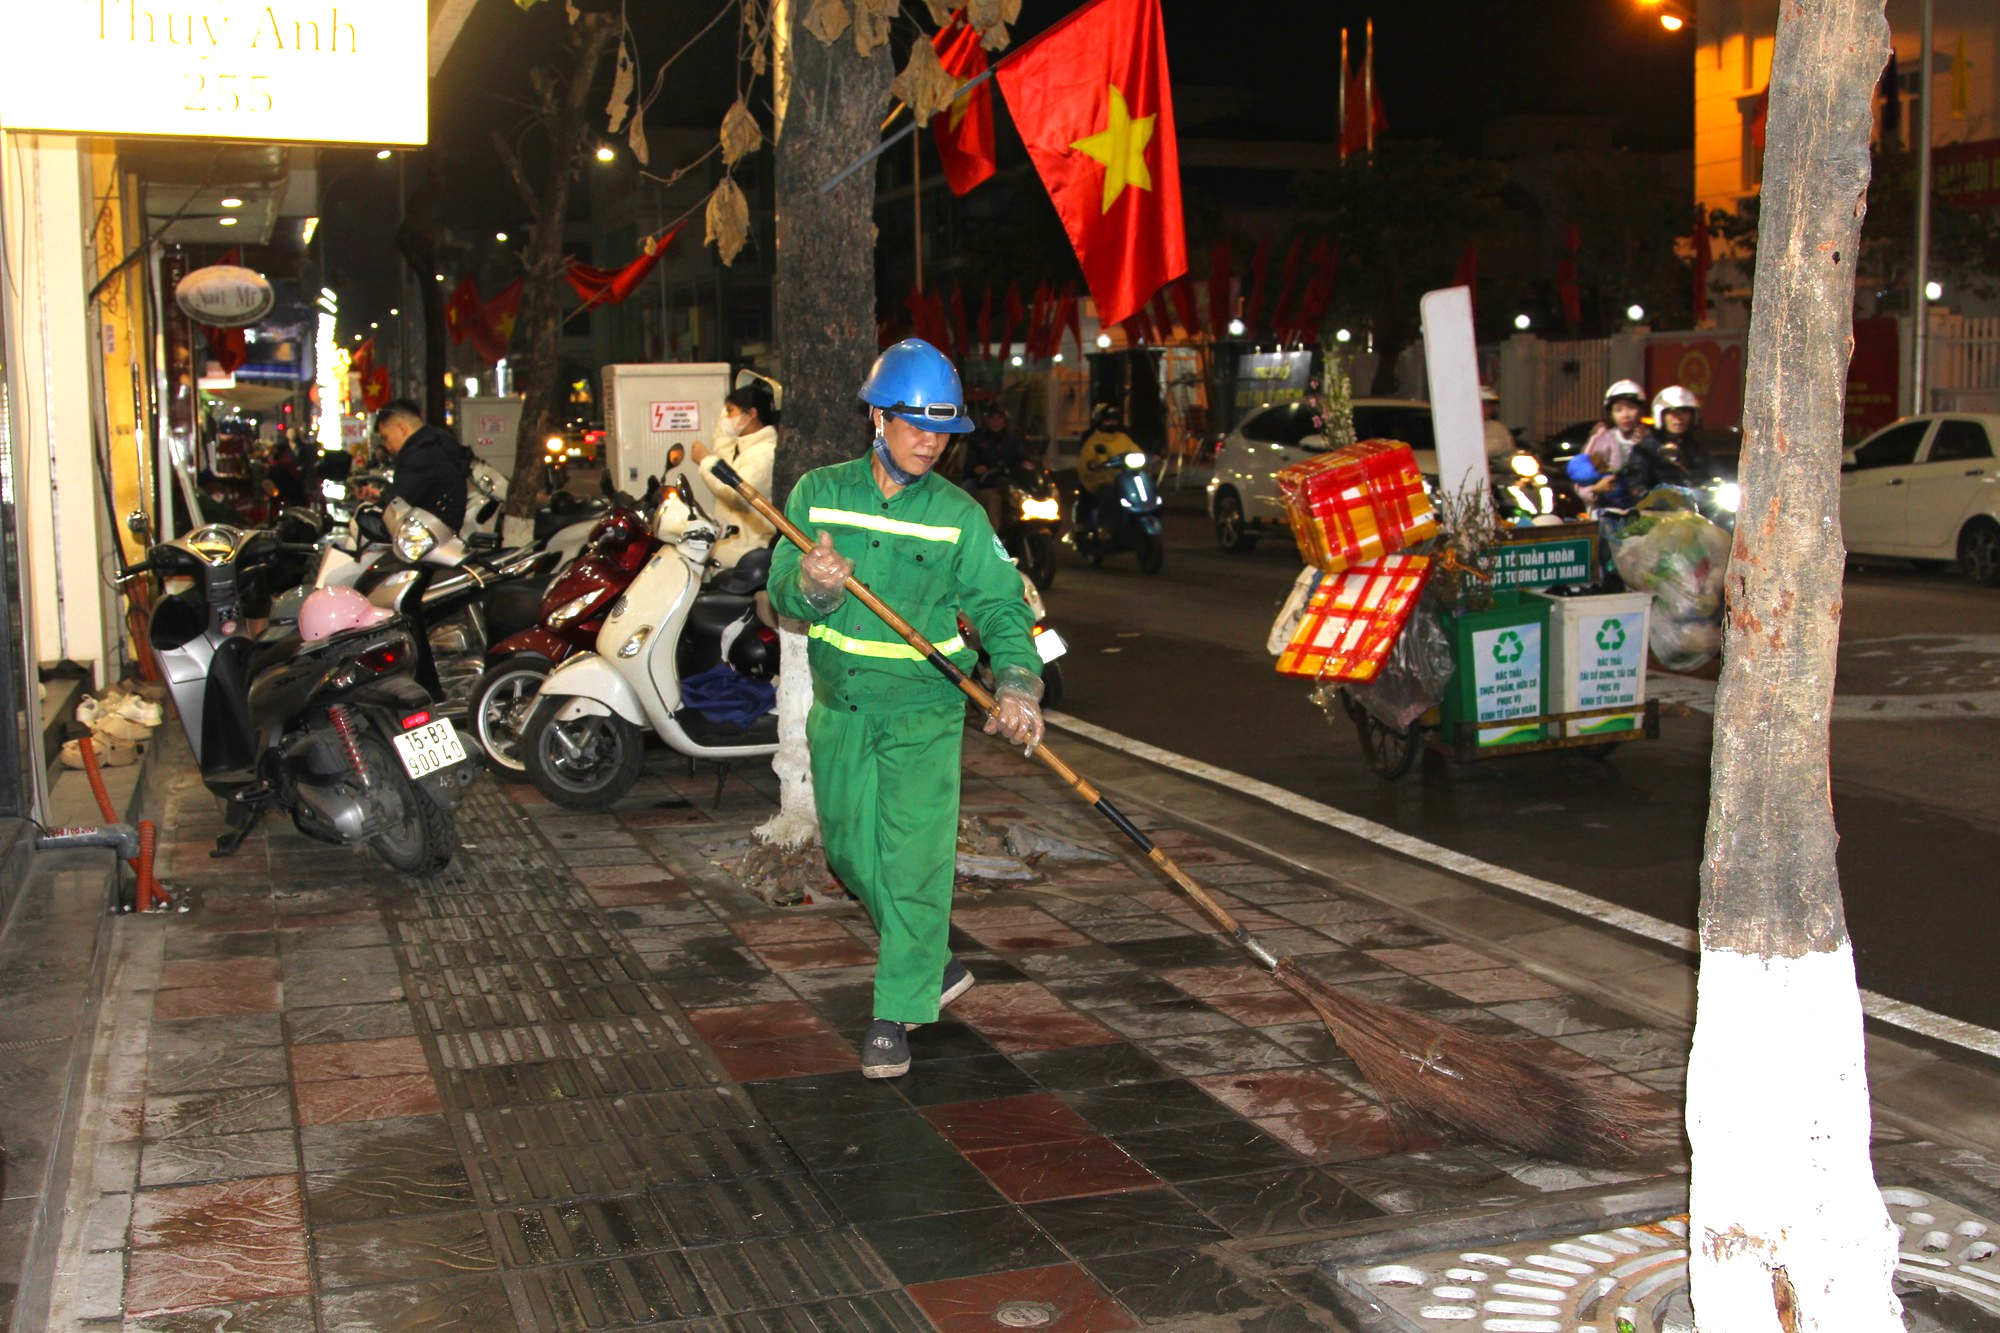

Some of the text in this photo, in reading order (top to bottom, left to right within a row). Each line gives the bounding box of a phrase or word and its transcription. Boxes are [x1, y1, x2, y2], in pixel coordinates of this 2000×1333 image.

[250, 5, 358, 53] Anh
[184, 73, 273, 113] 255
[1504, 550, 1516, 568] TẾ
[1519, 548, 1545, 567] TUẦN
[1547, 547, 1575, 564] HOÀN
[1541, 567, 1557, 581] LAI
[1559, 564, 1585, 579] XANH
[405, 723, 448, 752] 15-B3
